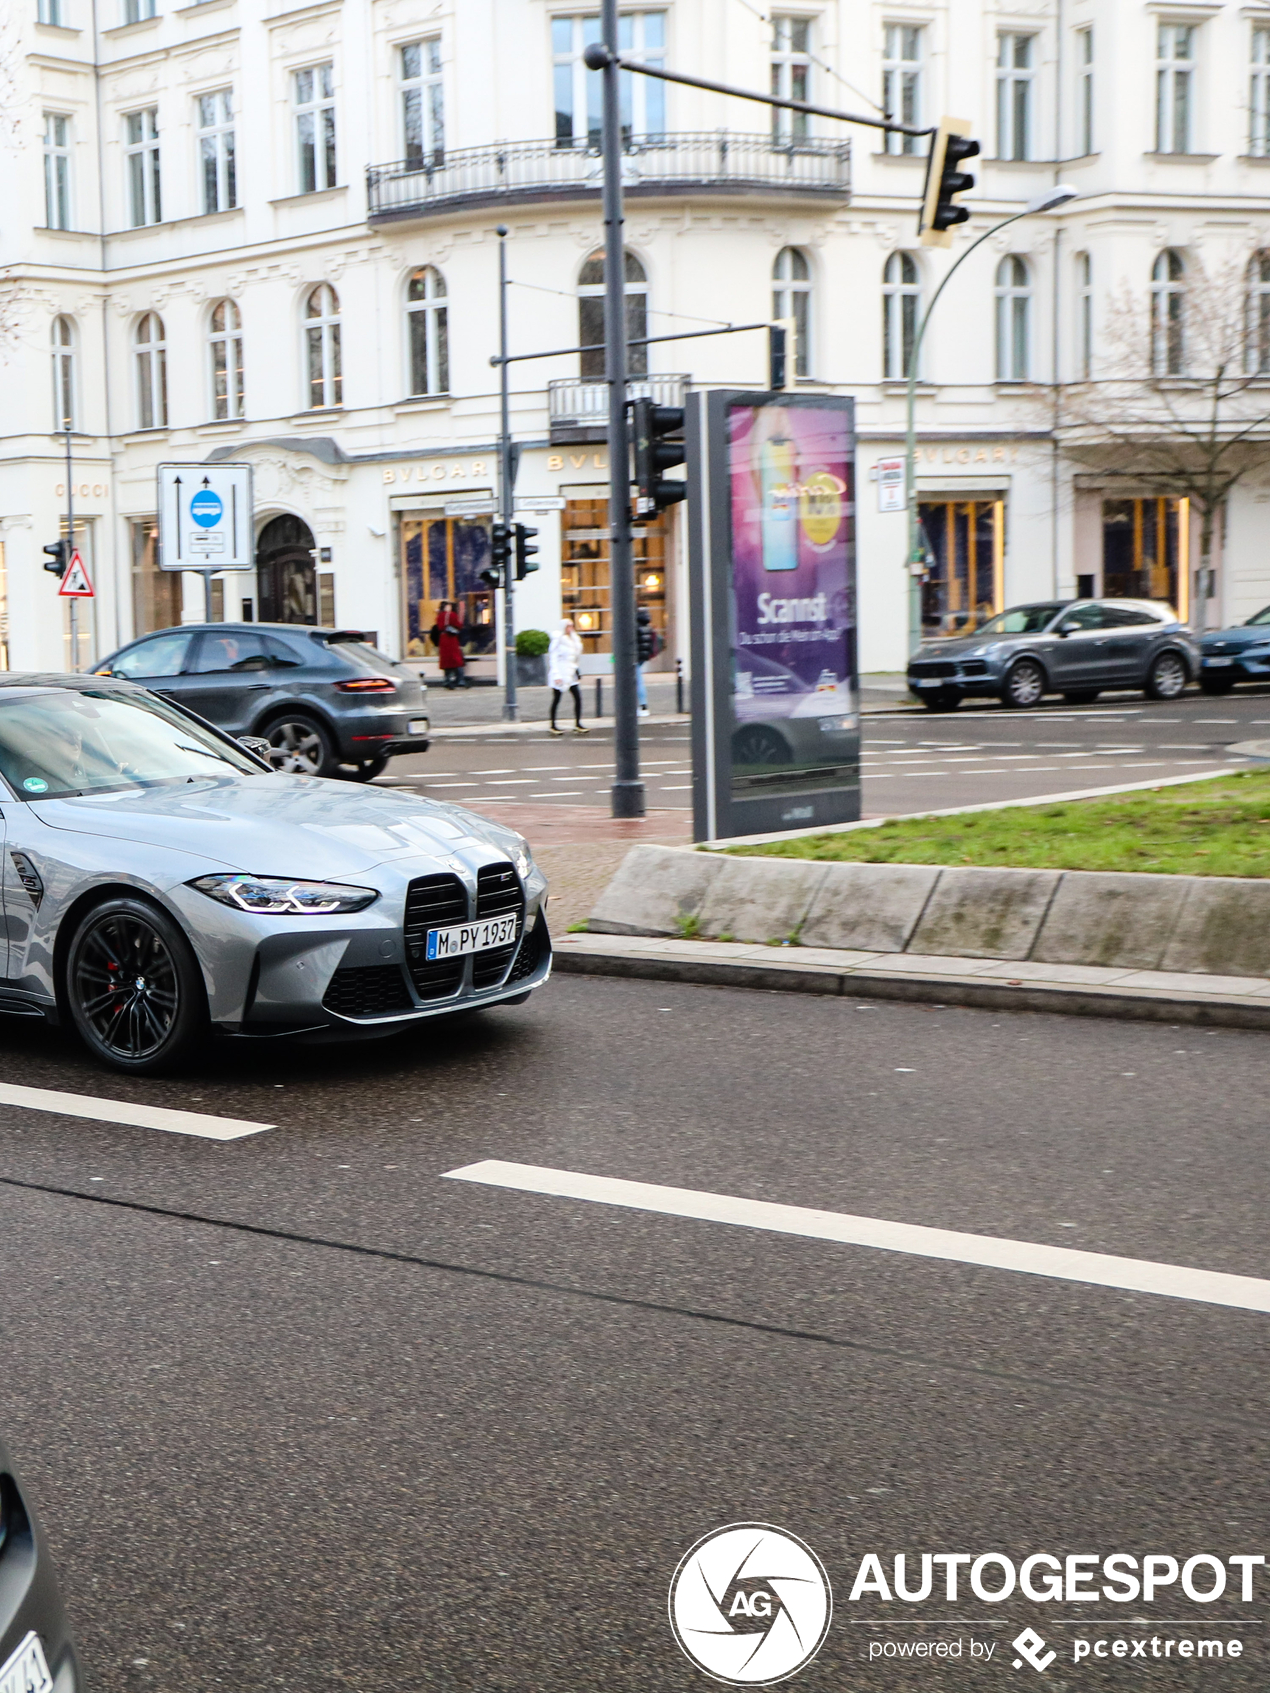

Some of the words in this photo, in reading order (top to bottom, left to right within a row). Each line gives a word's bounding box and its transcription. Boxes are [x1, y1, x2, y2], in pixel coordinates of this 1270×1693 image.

[382, 460, 488, 485] BVLGAR
[757, 592, 828, 624] Scannst
[438, 932, 449, 955] M
[460, 927, 479, 951] PY
[482, 919, 514, 946] 1937
